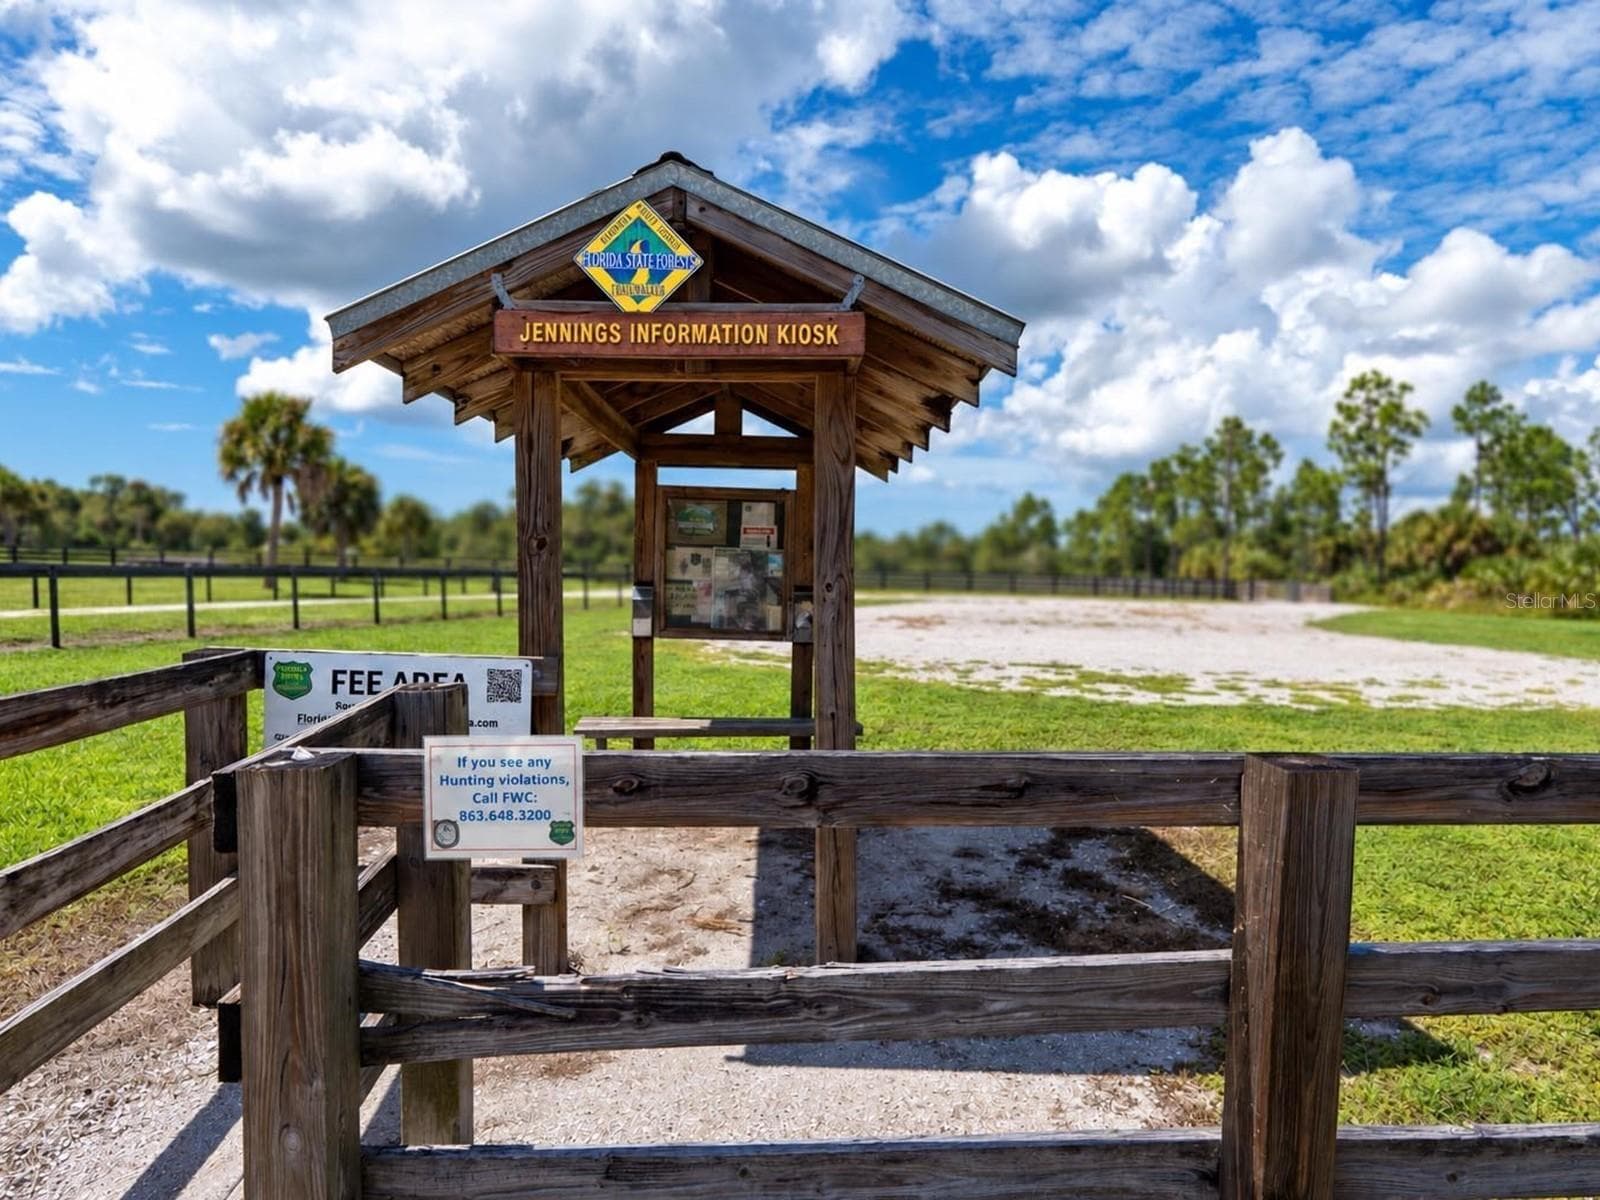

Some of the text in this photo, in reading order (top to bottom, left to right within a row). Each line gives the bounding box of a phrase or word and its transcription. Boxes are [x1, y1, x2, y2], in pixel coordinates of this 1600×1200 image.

[583, 251, 697, 271] FLORIDA STATE FORESTS
[519, 322, 839, 346] JENNINGS INFORMATION KIOSK
[331, 669, 383, 696] FEE
[457, 756, 552, 770] If you see any
[440, 774, 570, 788] Hunting violations,
[472, 791, 538, 804] Call FWC:
[459, 809, 552, 822] 863.648.3200
